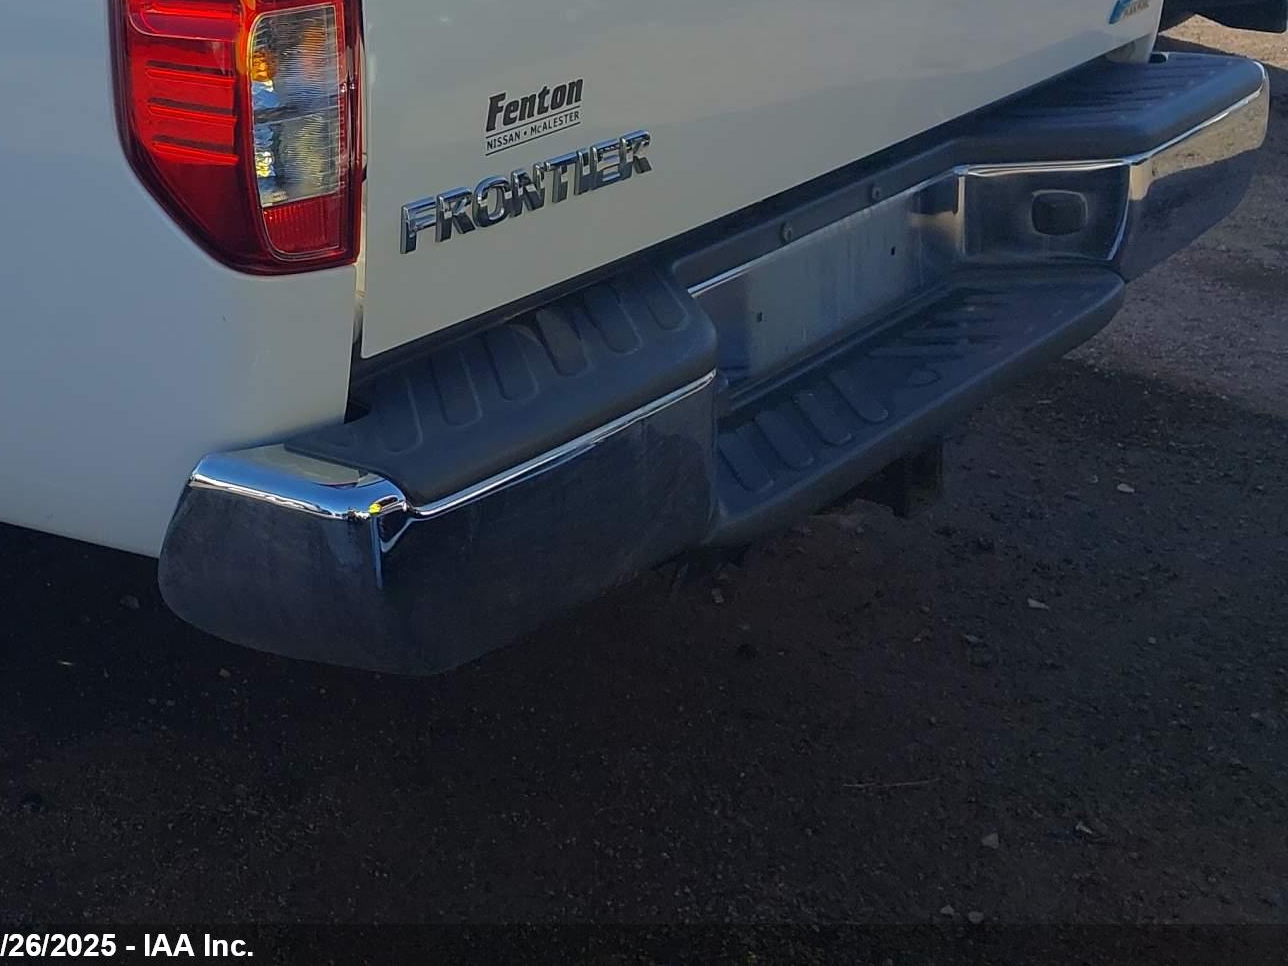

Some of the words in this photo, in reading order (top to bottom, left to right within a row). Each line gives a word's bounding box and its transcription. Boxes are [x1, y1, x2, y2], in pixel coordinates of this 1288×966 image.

[485, 78, 584, 133] Fenton
[486, 130, 521, 151] NISSAN
[530, 110, 580, 135] McALESTER
[400, 129, 652, 254] FRONTIER
